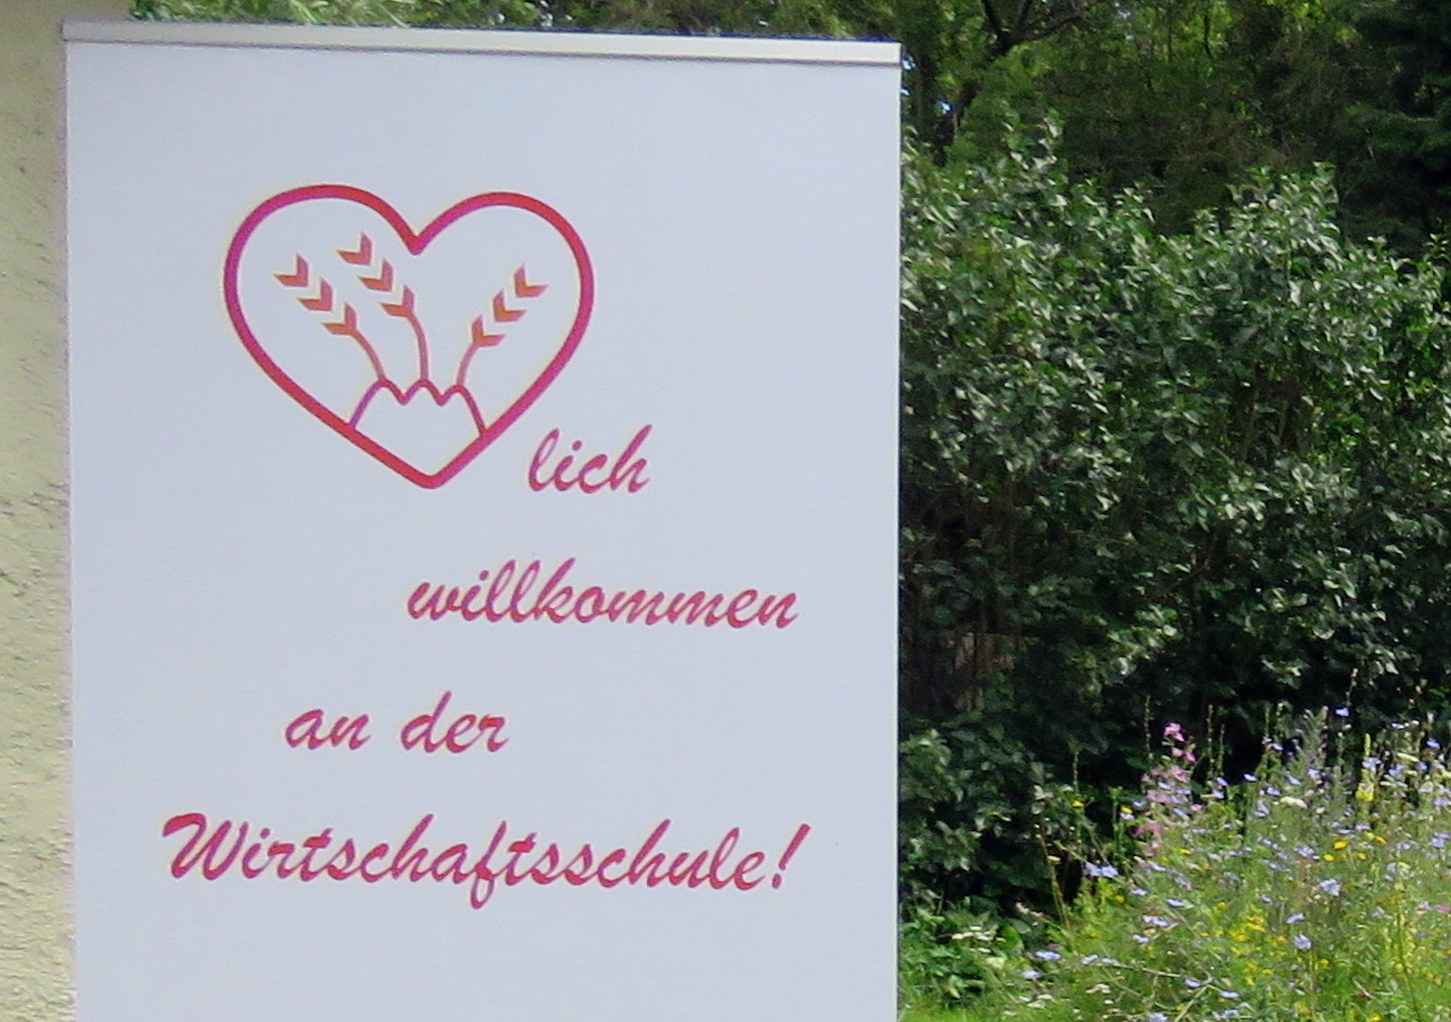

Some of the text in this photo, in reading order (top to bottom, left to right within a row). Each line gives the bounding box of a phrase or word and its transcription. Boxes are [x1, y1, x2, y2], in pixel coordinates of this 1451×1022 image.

[527, 425, 653, 495] lich
[406, 557, 799, 630] willkommen
[284, 690, 510, 755] an der
[161, 812, 812, 911] Wirtschaftsschule!
